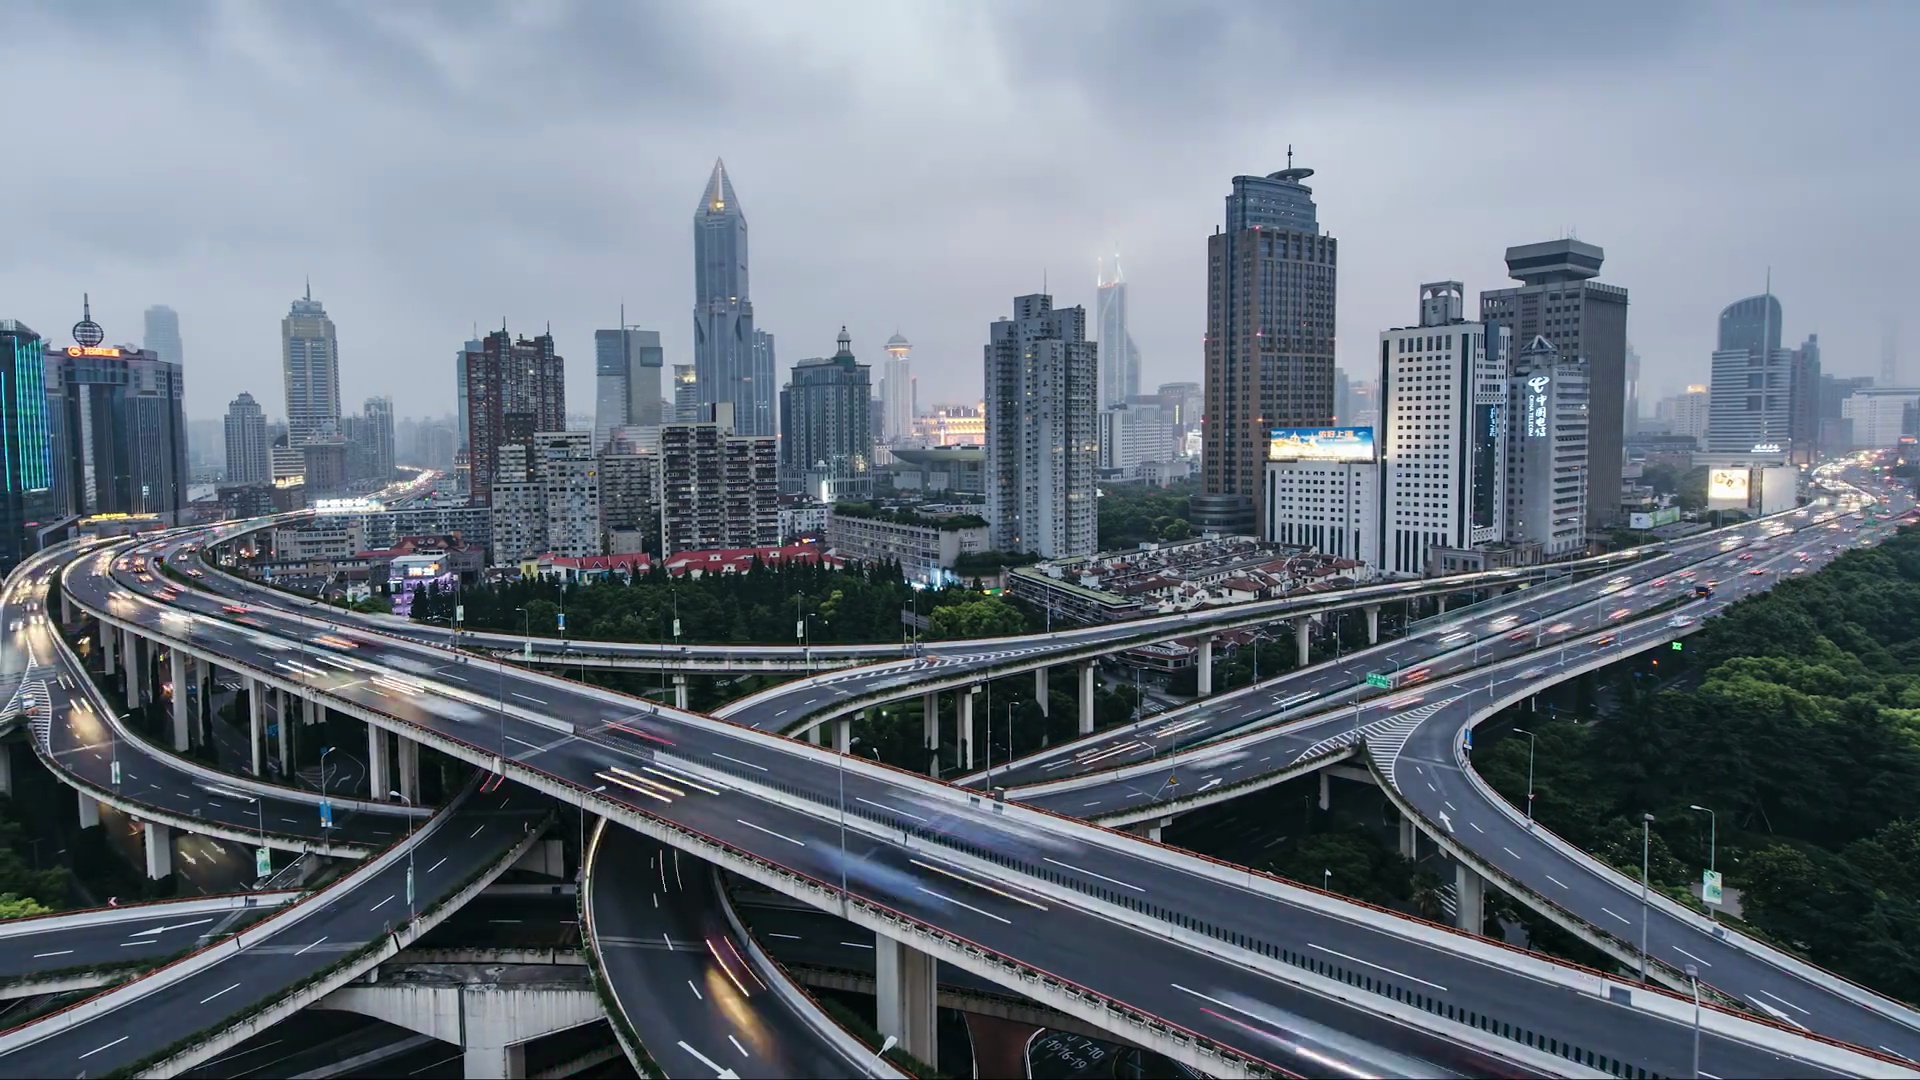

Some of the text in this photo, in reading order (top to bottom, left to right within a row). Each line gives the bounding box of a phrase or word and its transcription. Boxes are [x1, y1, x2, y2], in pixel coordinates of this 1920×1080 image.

[1535, 394, 1547, 437] 中国电信
[1078, 1040, 1105, 1060] 7-10
